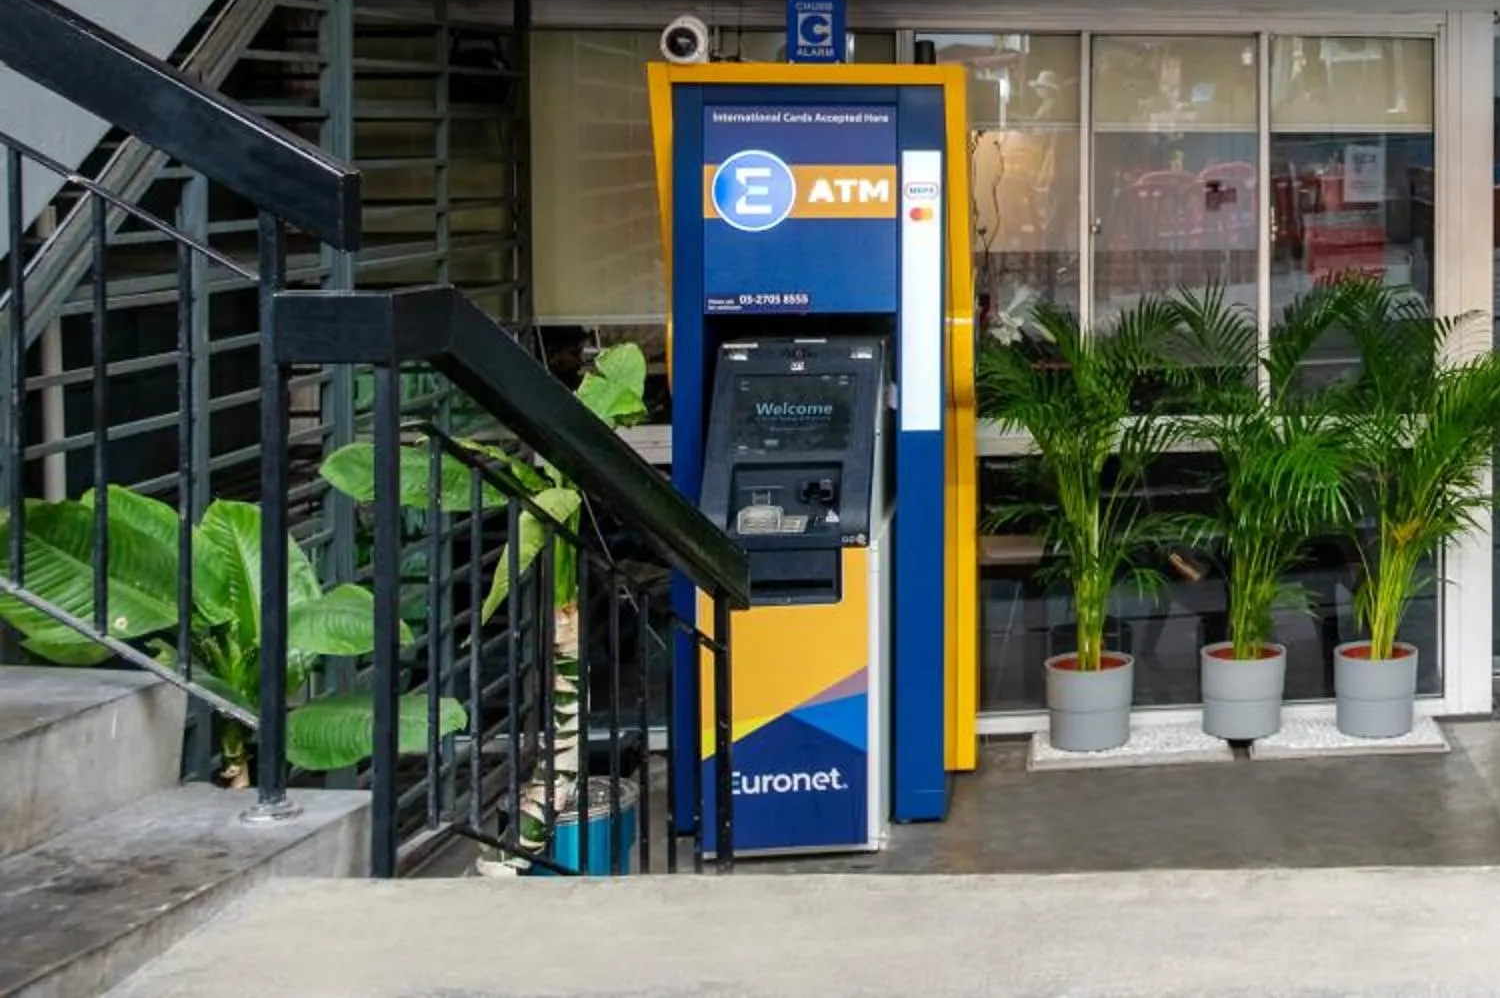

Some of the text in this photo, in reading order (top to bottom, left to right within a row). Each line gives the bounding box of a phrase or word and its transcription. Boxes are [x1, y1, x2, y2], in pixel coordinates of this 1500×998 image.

[797, 47, 834, 57] ALARM
[713, 112, 889, 125] International Cards Accepted Here
[808, 179, 890, 203] ATM
[755, 402, 833, 415] Welcome
